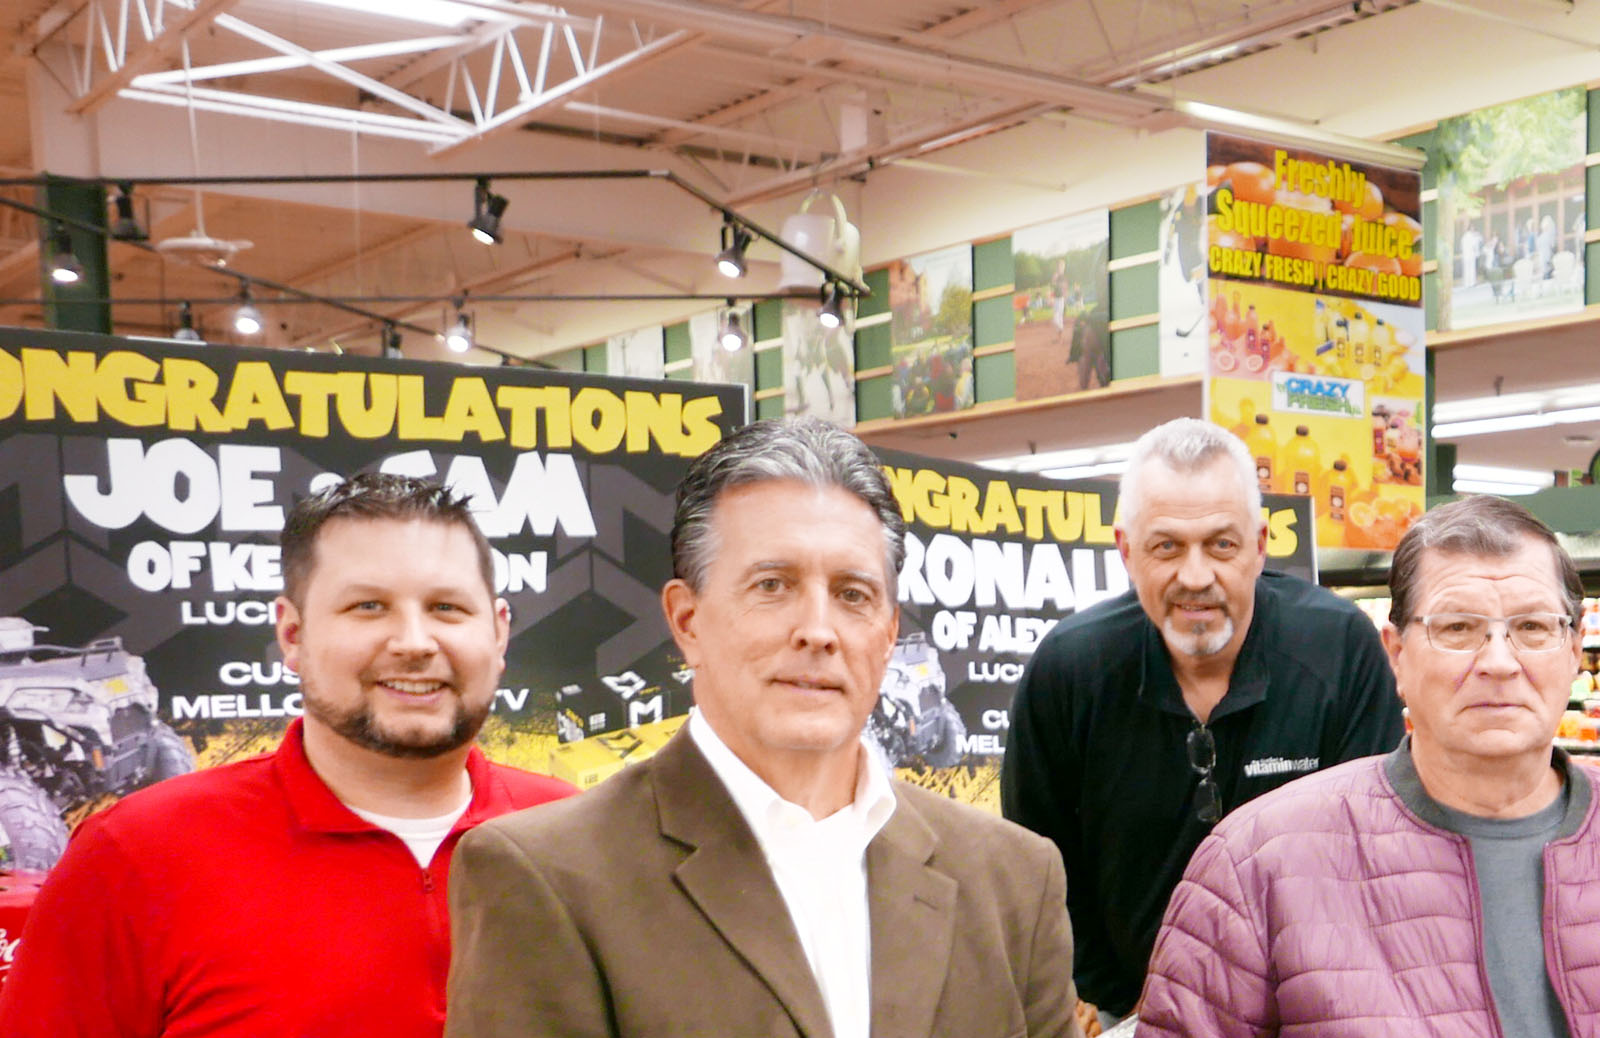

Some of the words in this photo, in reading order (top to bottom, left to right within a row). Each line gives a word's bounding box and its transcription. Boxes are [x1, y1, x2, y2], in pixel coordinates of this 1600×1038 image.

[1274, 149, 1367, 209] Freshly
[1215, 188, 1343, 250] Squeezed
[1351, 216, 1413, 260] Juice
[1209, 245, 1263, 278] CRAZY
[1264, 255, 1316, 286] FRESH
[1326, 264, 1376, 297] CRAZY
[1376, 273, 1421, 301] GOOD
[1286, 377, 1351, 398] CRAZY
[64, 438, 285, 534] JOE
[127, 541, 207, 592] OF
[931, 610, 977, 651] OF
[1243, 757, 1320, 778] vitaminwater
